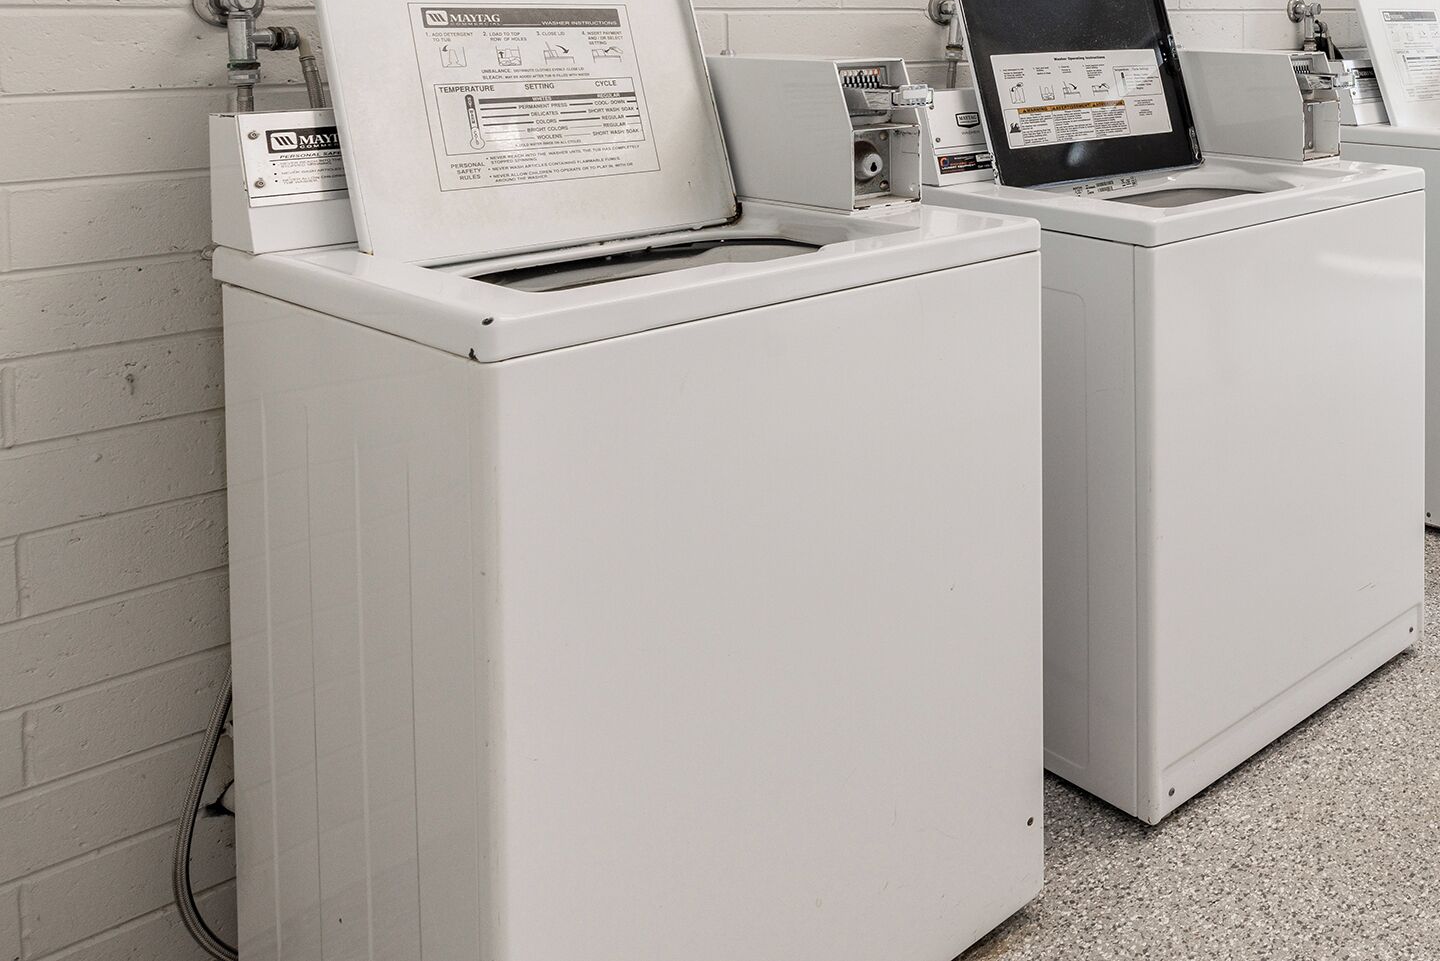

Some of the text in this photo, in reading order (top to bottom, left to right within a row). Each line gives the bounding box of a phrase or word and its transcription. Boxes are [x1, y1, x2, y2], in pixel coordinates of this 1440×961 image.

[449, 14, 501, 23] MAYTAG
[439, 84, 495, 93] TEMPERATURE
[449, 161, 485, 169] PERSONAL
